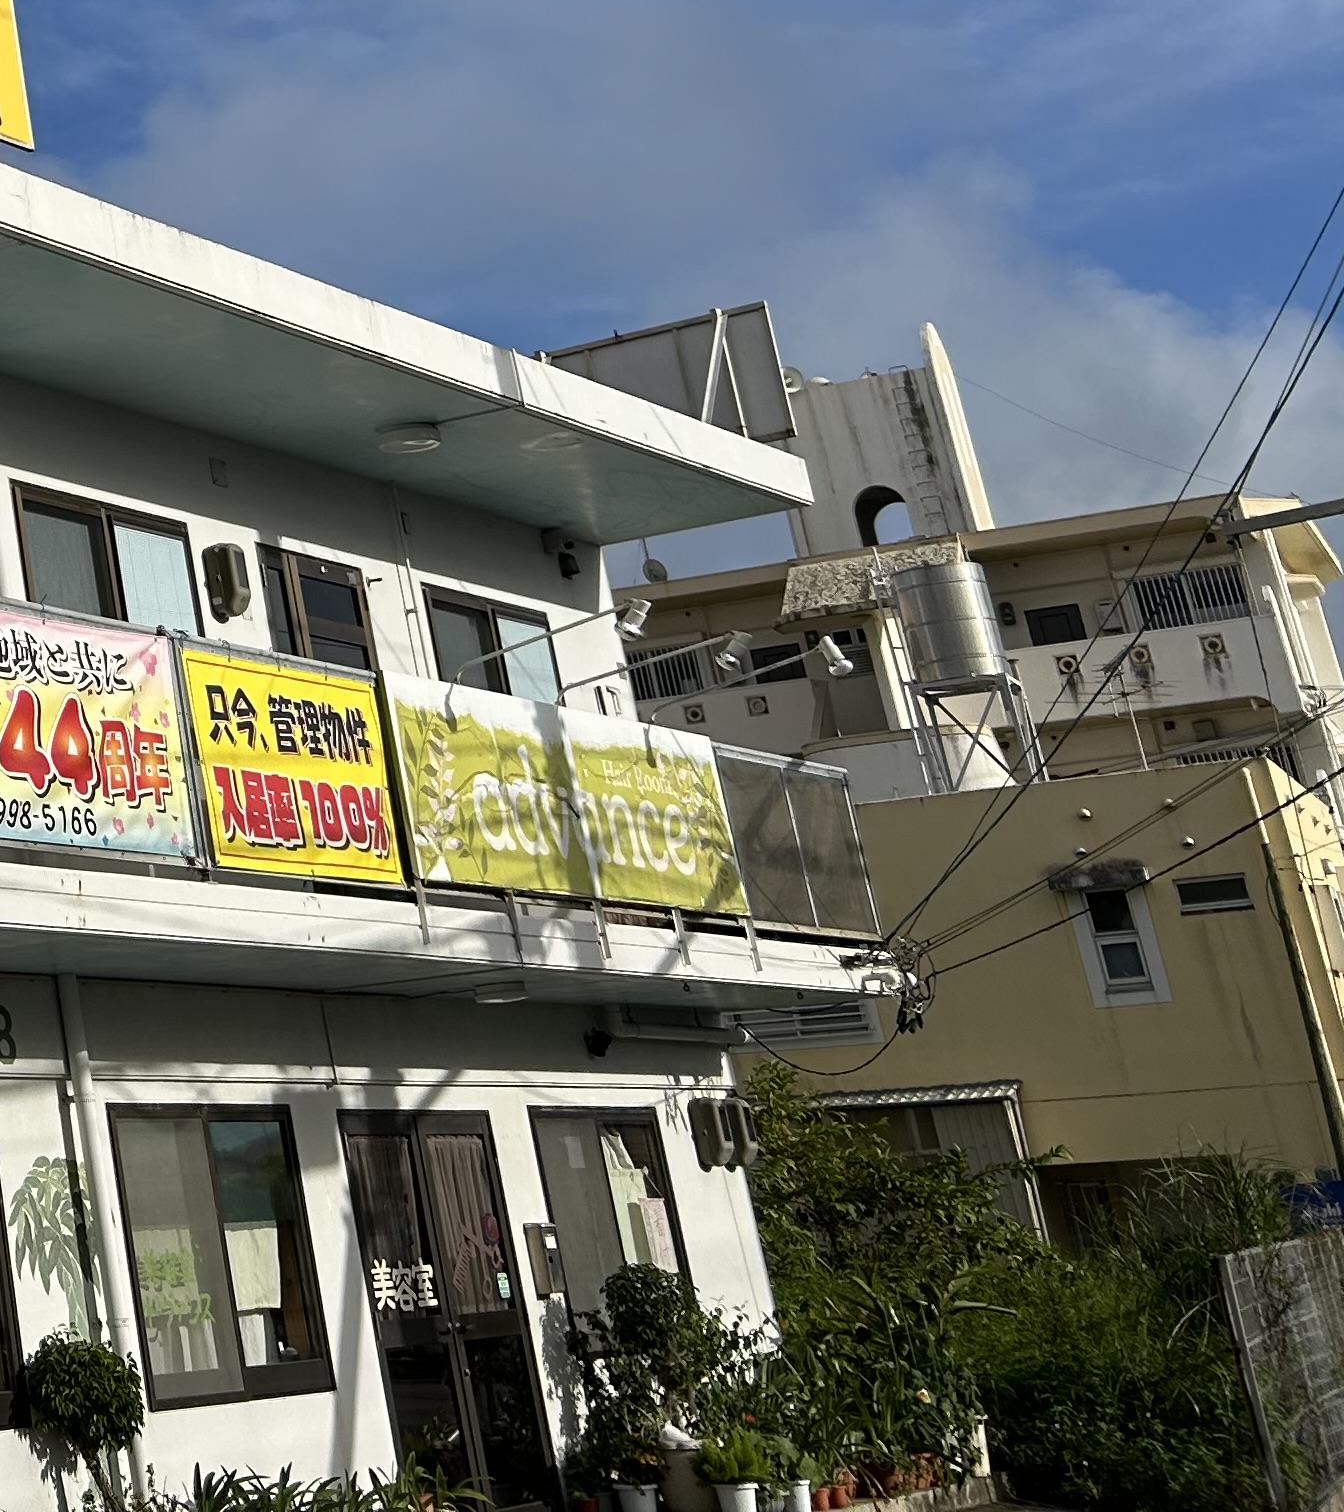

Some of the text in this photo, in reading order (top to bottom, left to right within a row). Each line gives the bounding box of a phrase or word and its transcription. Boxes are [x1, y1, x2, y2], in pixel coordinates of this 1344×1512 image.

[473, 744, 696, 876] advance
[371, 1257, 439, 1312] 美容室
